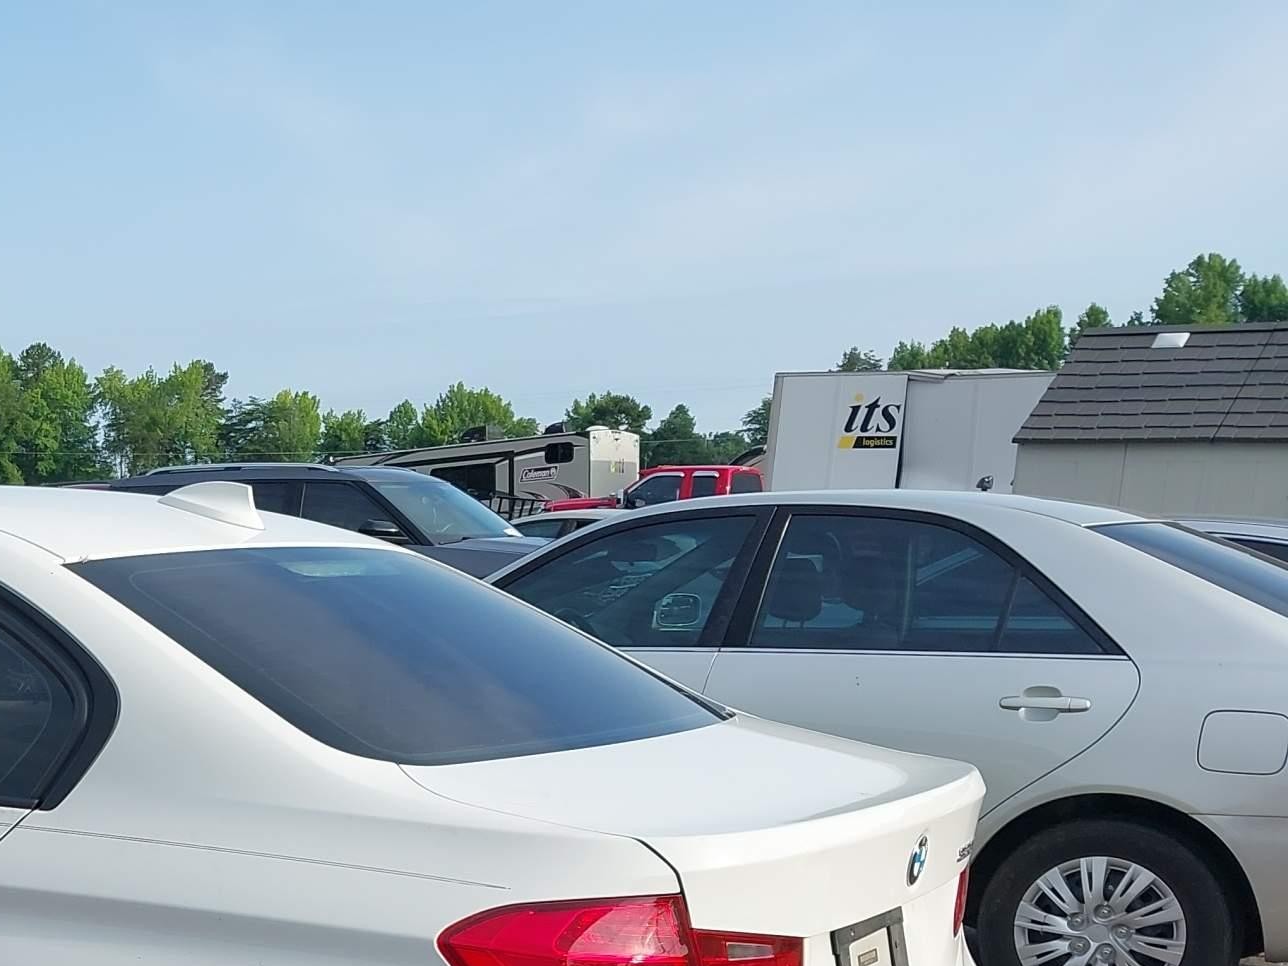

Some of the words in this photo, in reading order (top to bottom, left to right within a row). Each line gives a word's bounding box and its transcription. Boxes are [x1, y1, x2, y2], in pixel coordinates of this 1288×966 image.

[843, 393, 902, 433] its
[862, 436, 894, 446] logistics
[522, 468, 550, 479] Coleman
